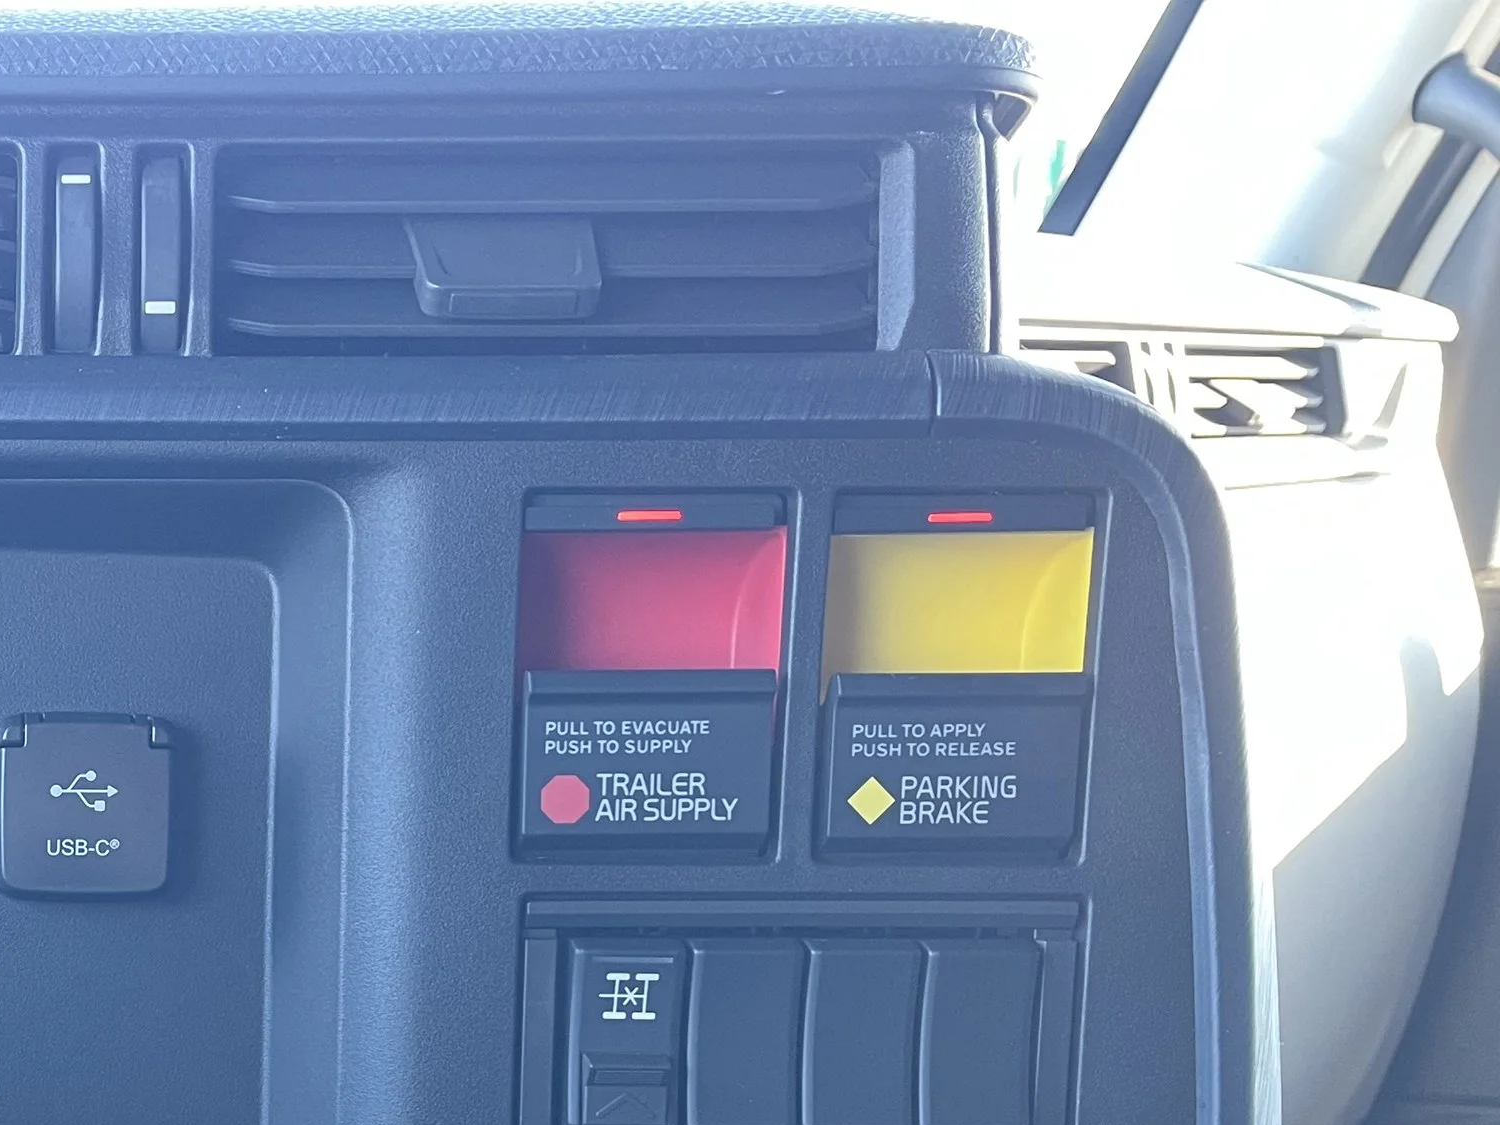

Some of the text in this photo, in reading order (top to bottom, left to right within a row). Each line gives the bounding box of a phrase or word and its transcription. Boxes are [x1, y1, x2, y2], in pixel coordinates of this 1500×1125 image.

[546, 720, 710, 735] PULL TO EVACUATE
[852, 723, 986, 738] PULL TO APPLY
[545, 739, 692, 754] PUSH TO SUPPLY
[852, 742, 1016, 757] PUSH TO RELEASE
[596, 773, 706, 796] TRAILER
[901, 776, 1017, 799] PARKING
[595, 798, 739, 822] AIR SUPPLY
[900, 801, 989, 825] BRAKE
